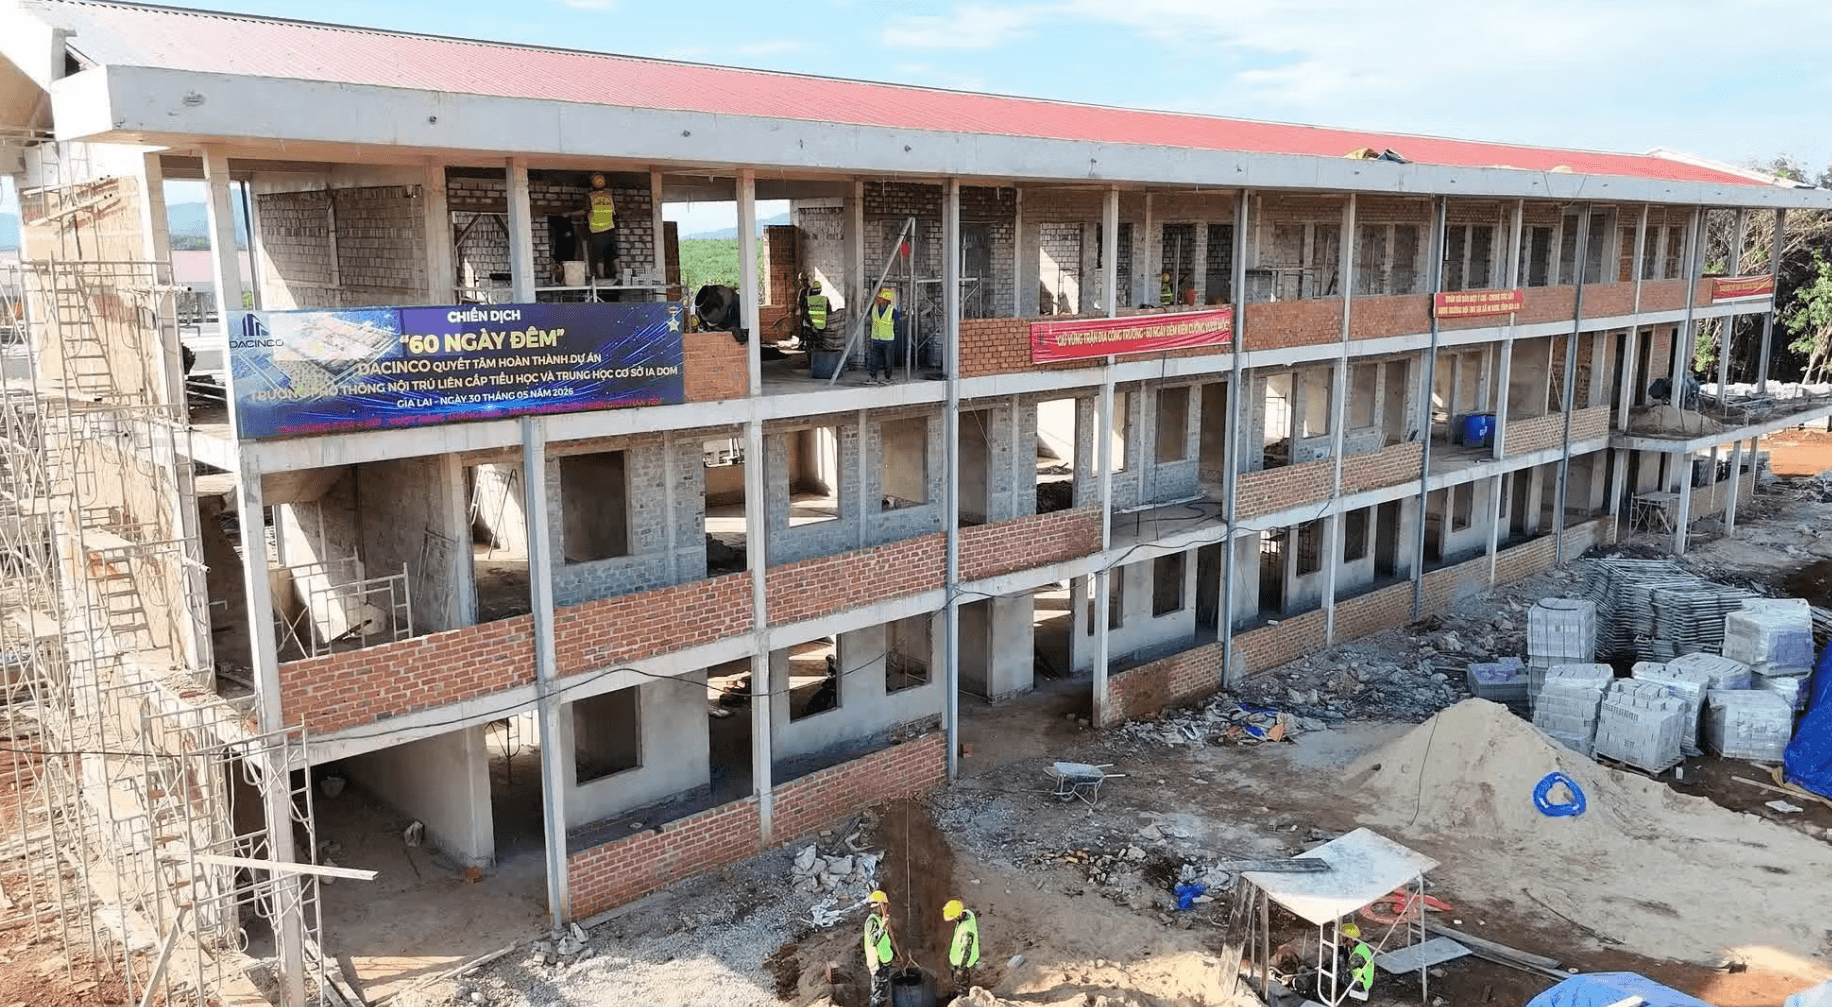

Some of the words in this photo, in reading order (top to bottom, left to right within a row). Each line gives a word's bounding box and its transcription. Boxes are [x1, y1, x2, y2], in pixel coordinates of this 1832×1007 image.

[447, 307, 488, 323] CHIẾN
[490, 310, 521, 324] DỊCH
[229, 339, 284, 348] DACINCO
[444, 328, 506, 352] NGÀY
[357, 360, 431, 376] DACINCO
[432, 357, 471, 373] QUYẾT
[472, 357, 496, 369] TÂM
[498, 355, 530, 368] HOÀN
[532, 353, 568, 365] THÀNH
[570, 352, 585, 365] DỰ
[586, 352, 602, 363] ÁN
[341, 382, 385, 395] THÔNG
[387, 380, 409, 393] NỘI
[411, 377, 436, 390] TRÚ
[438, 376, 463, 389] LIÊN
[465, 373, 488, 387] CẤP
[489, 372, 514, 385] TIỂU
[515, 373, 539, 385] HỌC
[540, 370, 555, 382] VÀ
[556, 370, 591, 381] TRUNG
[592, 369, 614, 381] HỌC
[615, 367, 630, 378] CƠ
[630, 366, 644, 377] SỞ
[645, 367, 656, 377] IA
[656, 366, 678, 376] DOM
[397, 399, 415, 408] GIA
[417, 398, 433, 407] LAI
[440, 393, 467, 405] NGÀY
[468, 394, 481, 403] 30
[482, 391, 515, 402] THÁNG
[517, 390, 529, 400] 05
[529, 389, 552, 399] NĂM
[552, 387, 574, 397] 2026
